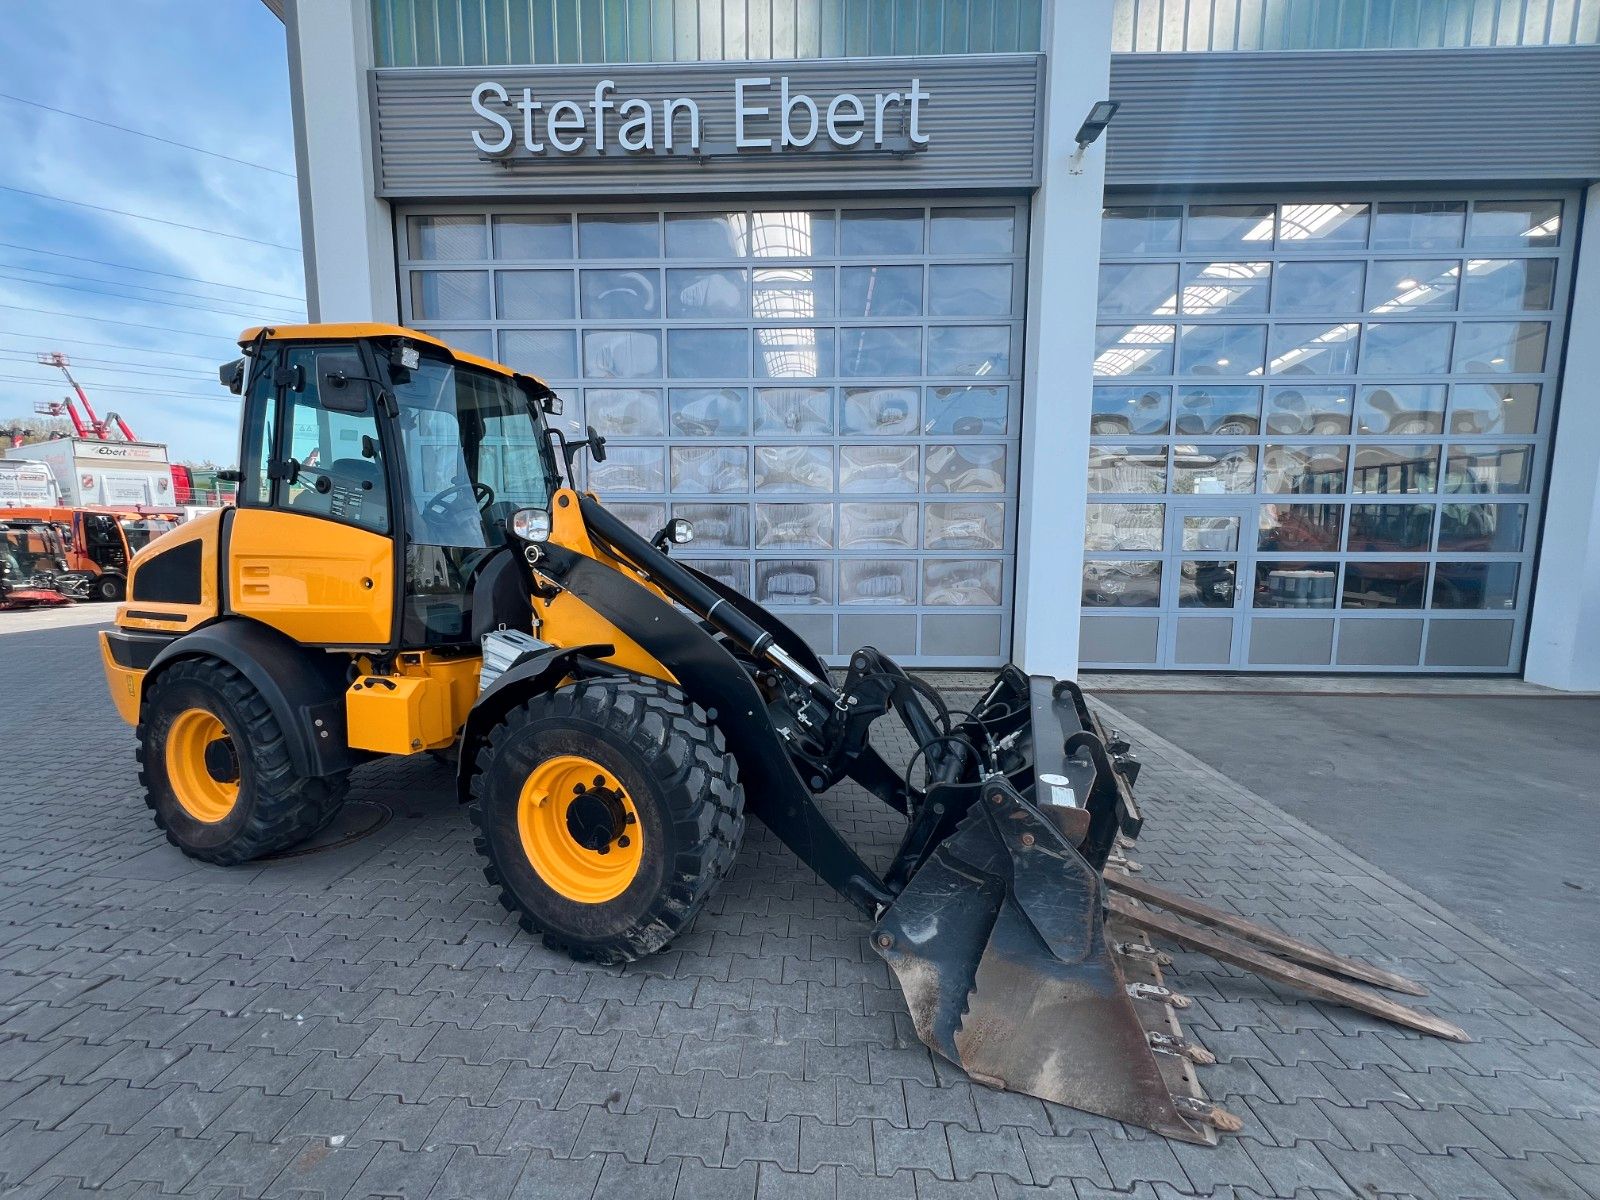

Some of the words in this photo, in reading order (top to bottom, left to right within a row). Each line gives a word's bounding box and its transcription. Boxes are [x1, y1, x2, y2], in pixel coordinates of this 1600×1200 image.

[471, 79, 700, 154] Stefan
[735, 76, 931, 150] Ebert
[98, 446, 127, 456] Ebert
